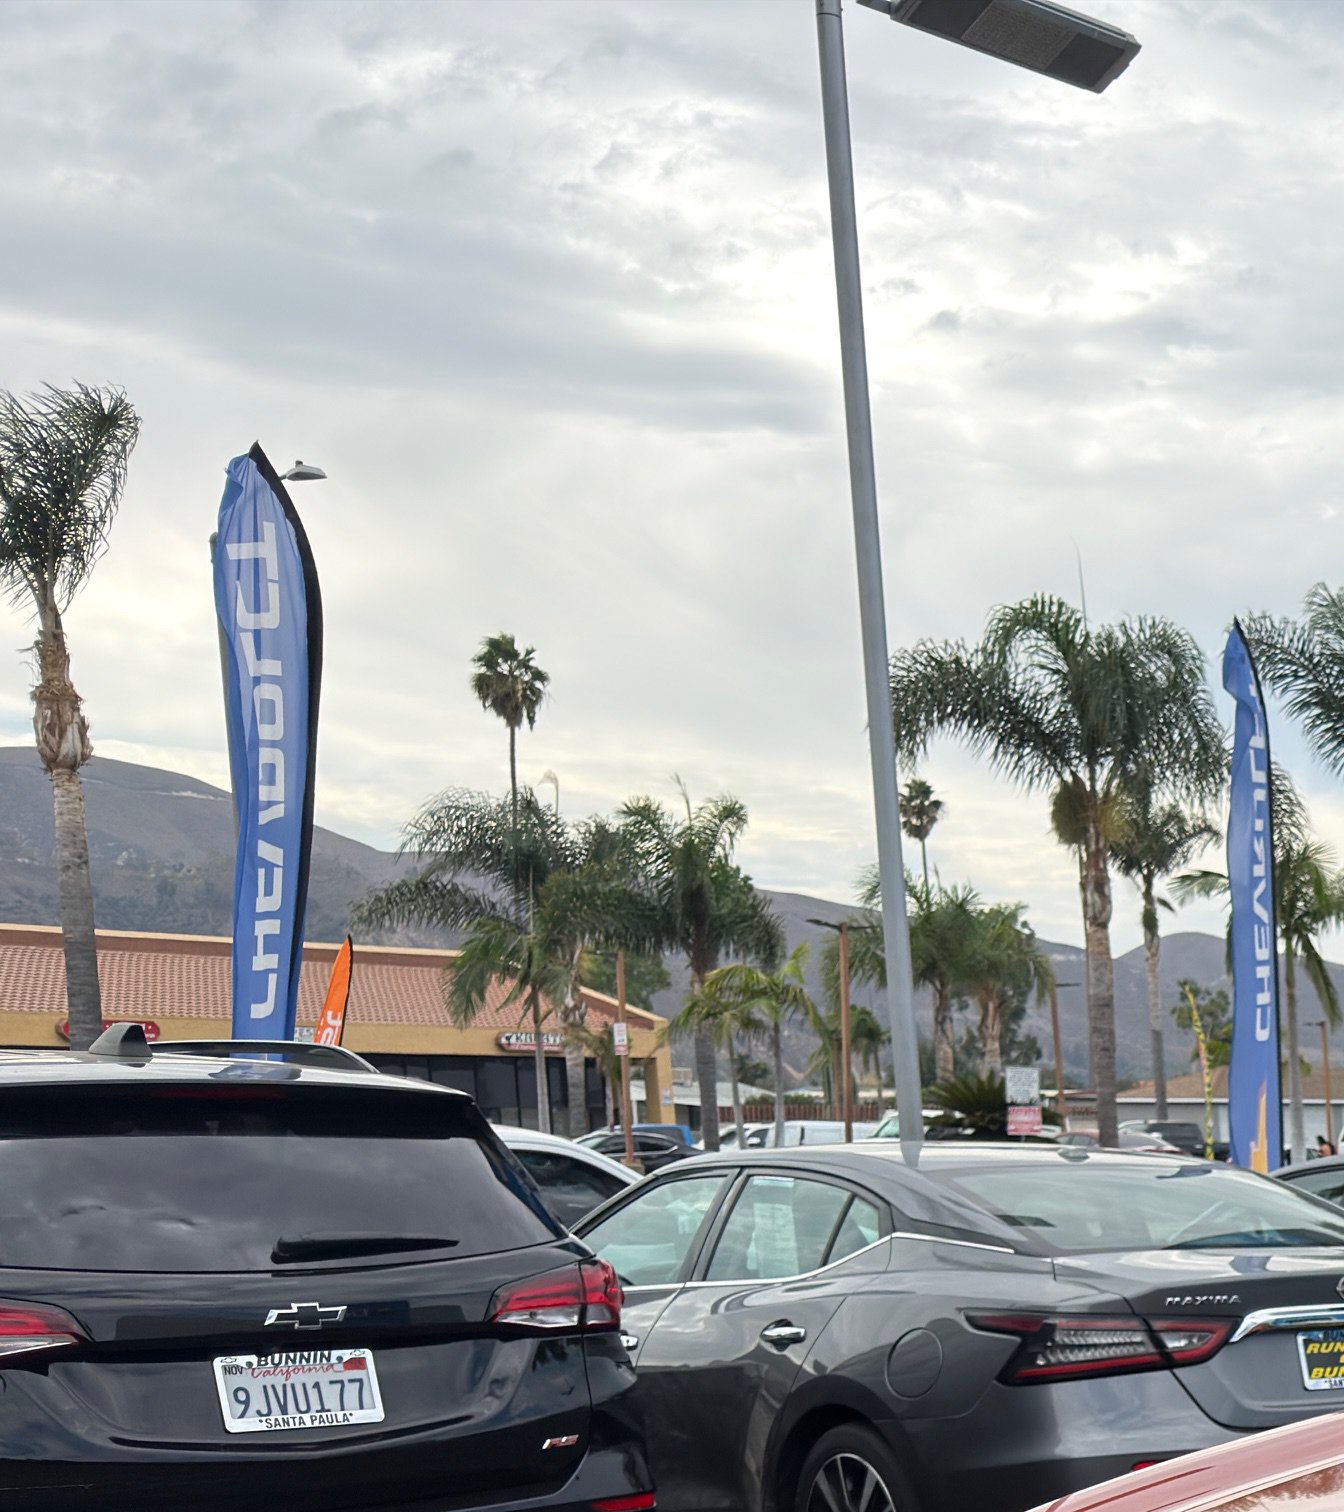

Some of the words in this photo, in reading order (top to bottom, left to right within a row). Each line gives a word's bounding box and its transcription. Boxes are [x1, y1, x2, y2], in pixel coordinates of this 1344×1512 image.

[1165, 1295, 1241, 1306] MAXIMA
[257, 1351, 332, 1367] BUNNIN
[224, 1366, 243, 1376] NOV
[251, 1364, 336, 1381] California
[232, 1378, 365, 1419] 9JVU177
